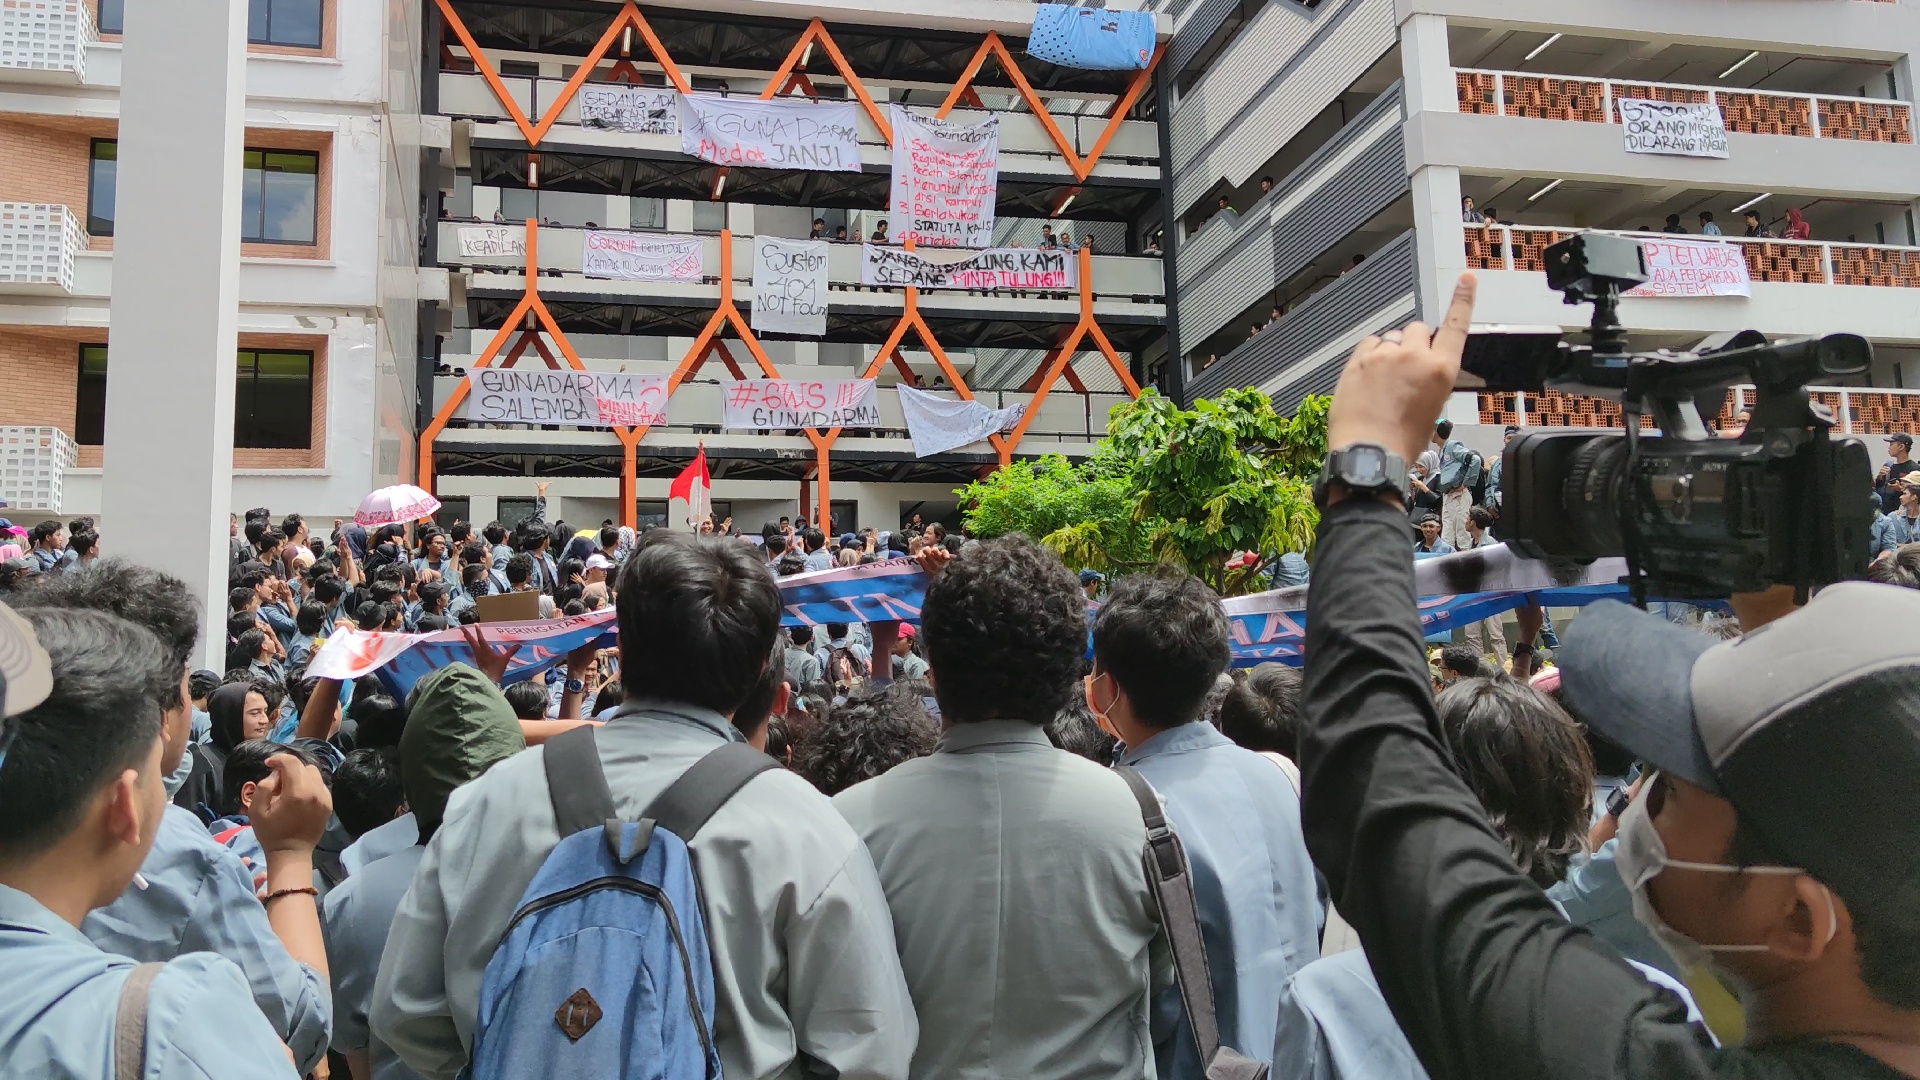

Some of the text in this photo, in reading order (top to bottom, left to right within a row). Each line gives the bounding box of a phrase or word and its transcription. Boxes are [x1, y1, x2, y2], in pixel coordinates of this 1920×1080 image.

[584, 91, 677, 109] SEDANG ADA
[1628, 120, 1687, 136] ORANG
[1625, 134, 1697, 152] DILARANG
[771, 143, 842, 168] JANJI
[486, 229, 508, 241] RIP
[914, 219, 962, 235] STATUTA
[464, 240, 527, 256] KEADILAN
[873, 265, 947, 287] SEDANG
[951, 269, 997, 287] MINTA
[1654, 268, 1678, 283] ADA
[757, 292, 789, 315] NOT
[481, 370, 635, 400] GUNADARMA
[481, 394, 591, 421] SALEMBA
[596, 398, 648, 415] MINIM
[752, 405, 880, 427] GUNADARMA
